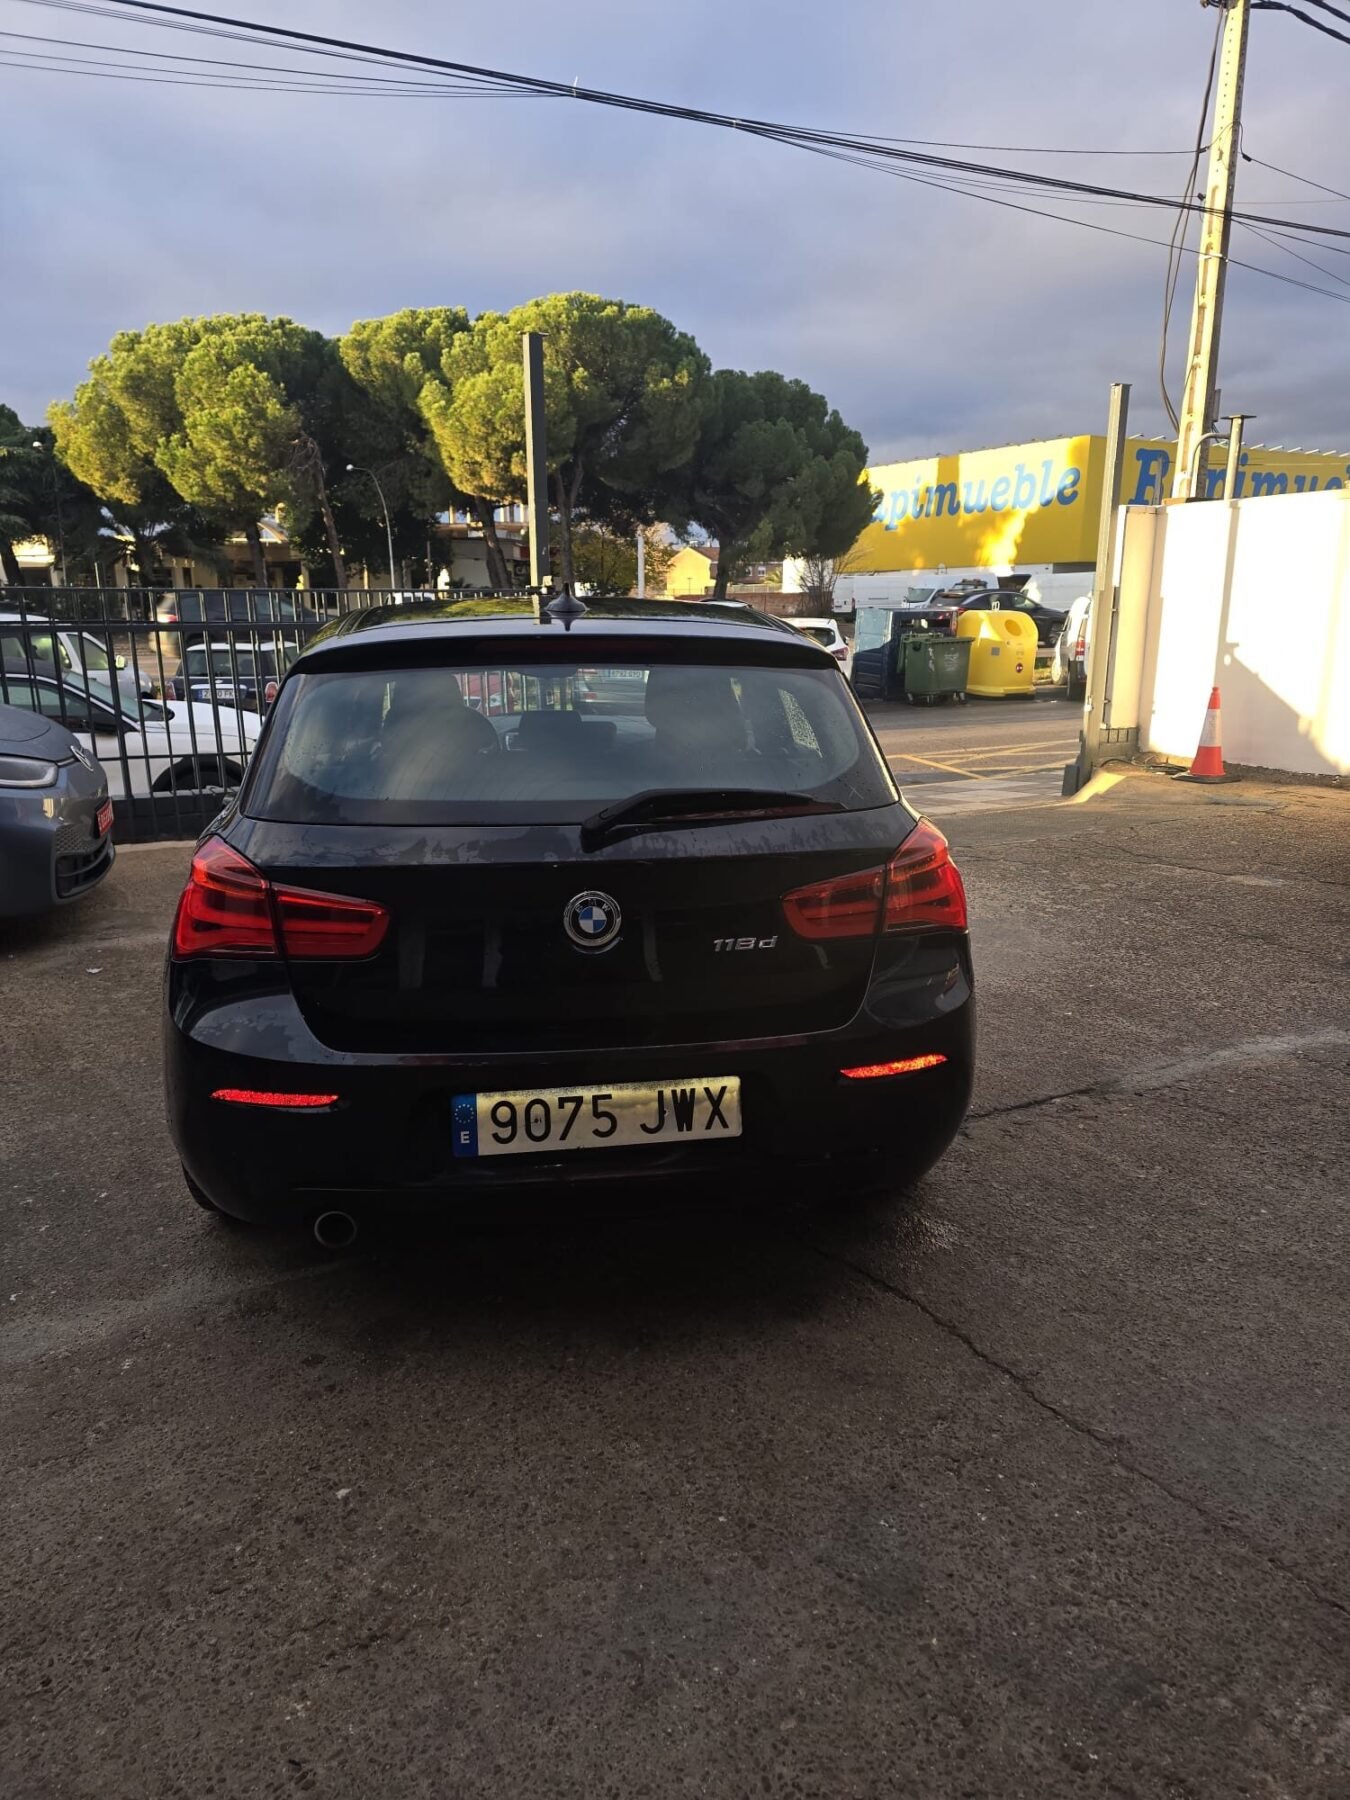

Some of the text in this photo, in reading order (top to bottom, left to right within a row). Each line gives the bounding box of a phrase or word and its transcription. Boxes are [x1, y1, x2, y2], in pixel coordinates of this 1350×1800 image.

[713, 935, 778, 952] 118d
[490, 1086, 729, 1145] 9075 JWX
[460, 1131, 471, 1144] E
